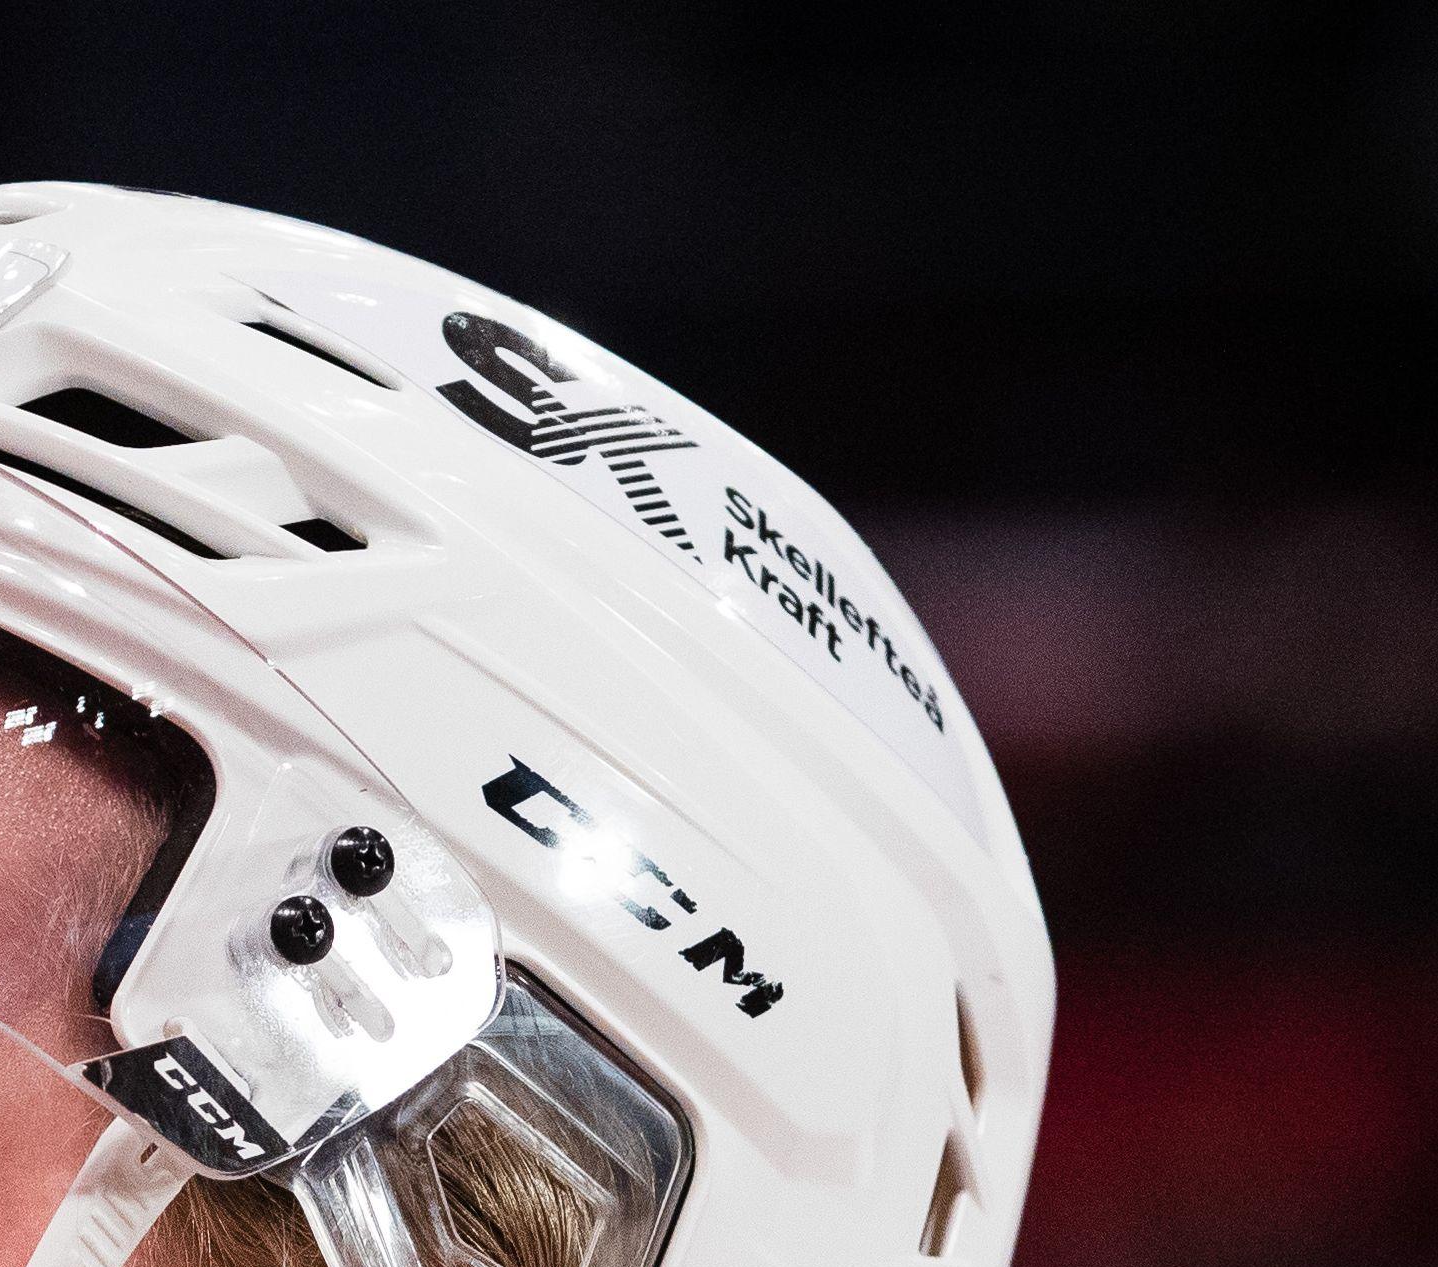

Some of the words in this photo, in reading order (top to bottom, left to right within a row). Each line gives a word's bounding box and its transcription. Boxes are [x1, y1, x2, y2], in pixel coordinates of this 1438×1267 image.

[723, 526, 843, 664] Kraft
[724, 486, 945, 735] Skellefteå
[153, 1051, 266, 1160] CCM
